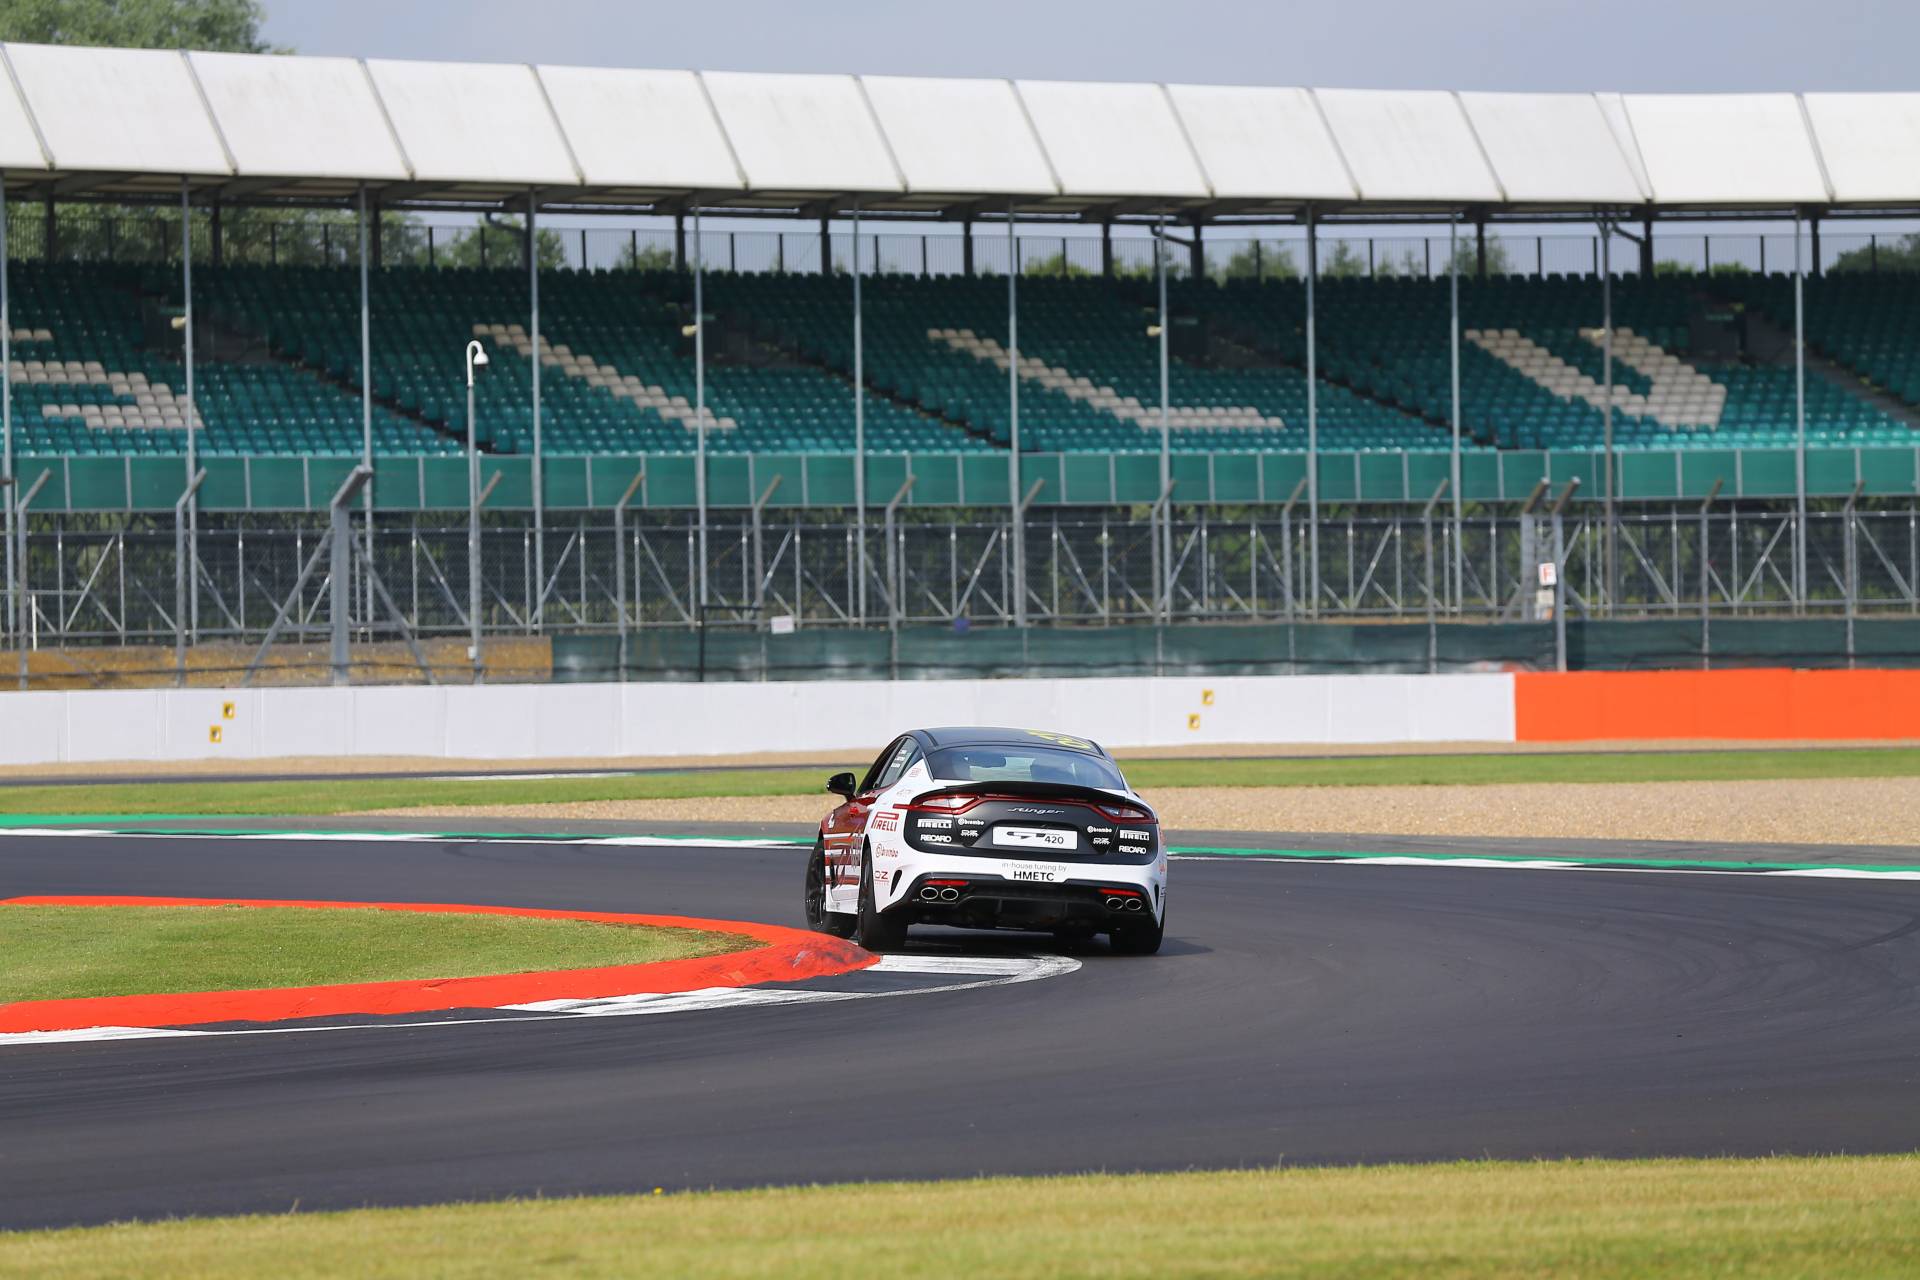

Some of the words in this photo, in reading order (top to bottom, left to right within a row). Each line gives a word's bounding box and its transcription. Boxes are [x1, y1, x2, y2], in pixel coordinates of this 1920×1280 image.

[1007, 806, 1065, 815] Stinger
[871, 811, 900, 832] PIRELLI
[917, 818, 952, 829] PIRELLI
[963, 818, 985, 826] brembo
[920, 833, 952, 843] RECARO
[1044, 836, 1064, 844] 420
[1119, 829, 1150, 841] PIRELLI
[1118, 845, 1147, 855] RECARO
[1001, 862, 1033, 870] in-house
[1034, 864, 1057, 872] tuning
[1058, 864, 1067, 872] by
[874, 870, 889, 880] OZ
[1013, 870, 1055, 881] HMETC
